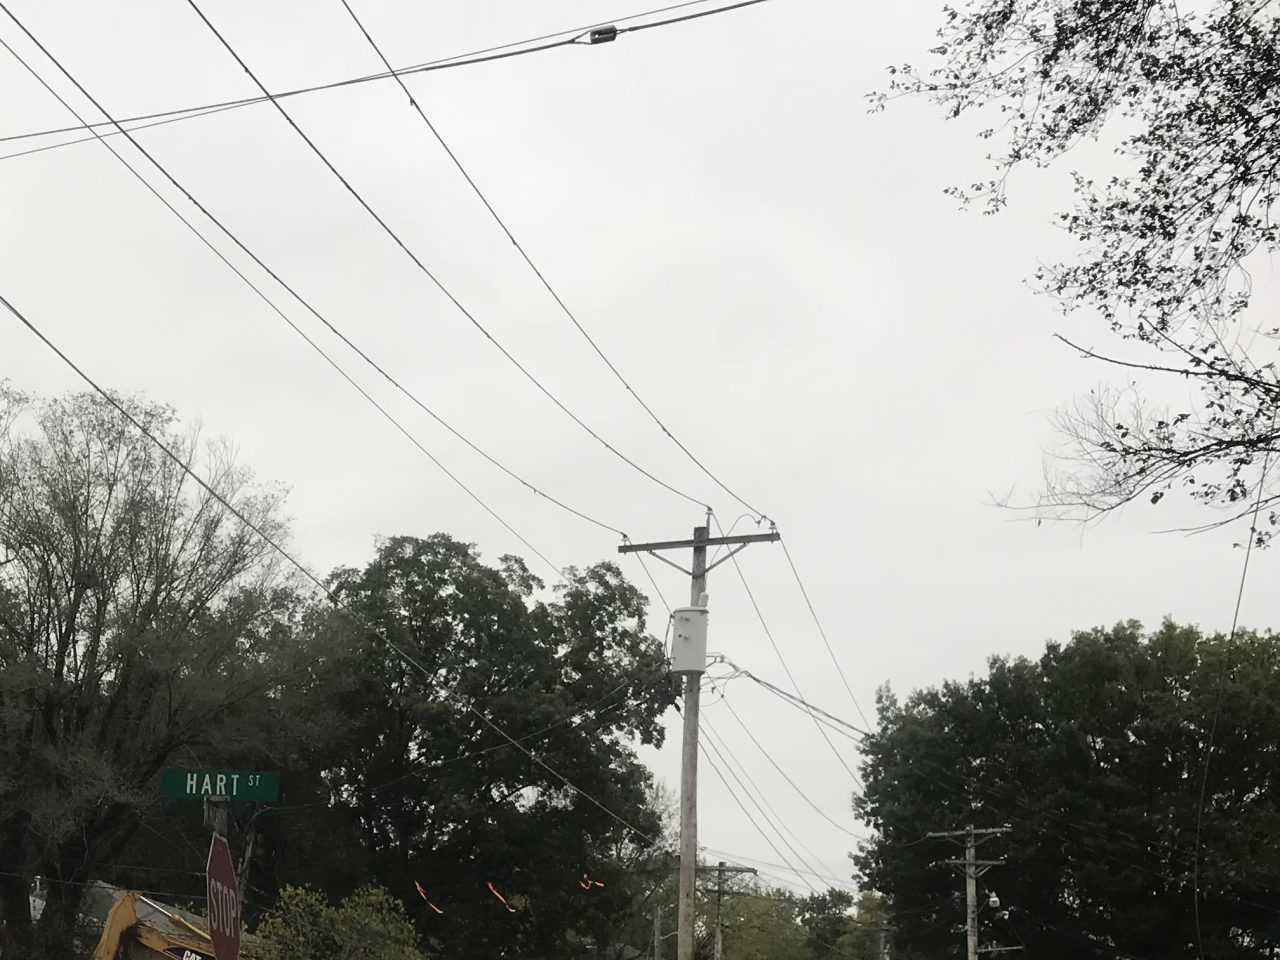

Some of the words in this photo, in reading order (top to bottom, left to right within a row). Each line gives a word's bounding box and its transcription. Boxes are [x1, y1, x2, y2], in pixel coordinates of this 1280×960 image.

[186, 773, 239, 795] HART
[248, 775, 260, 786] ST
[210, 878, 237, 938] STOP
